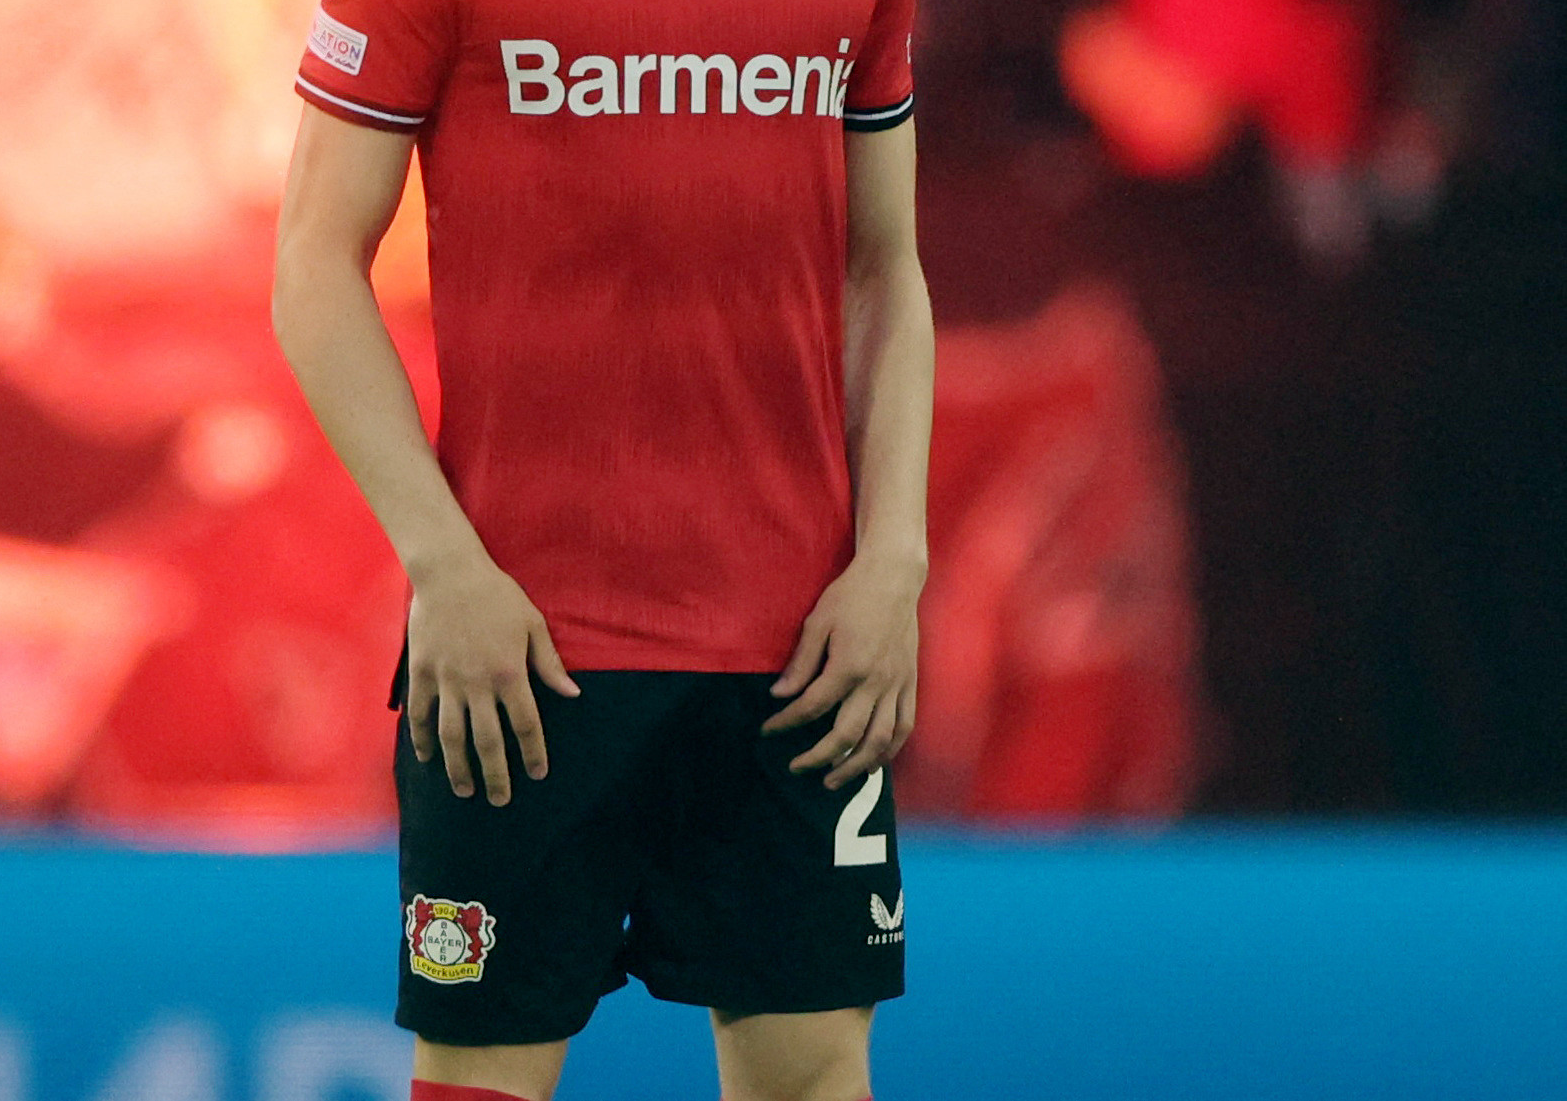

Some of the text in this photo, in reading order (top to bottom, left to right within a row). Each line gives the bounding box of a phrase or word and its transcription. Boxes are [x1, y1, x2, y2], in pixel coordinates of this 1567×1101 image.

[433, 906, 455, 918] 1904
[427, 935, 463, 948] BAYER
[416, 958, 474, 978] Leverkusen
